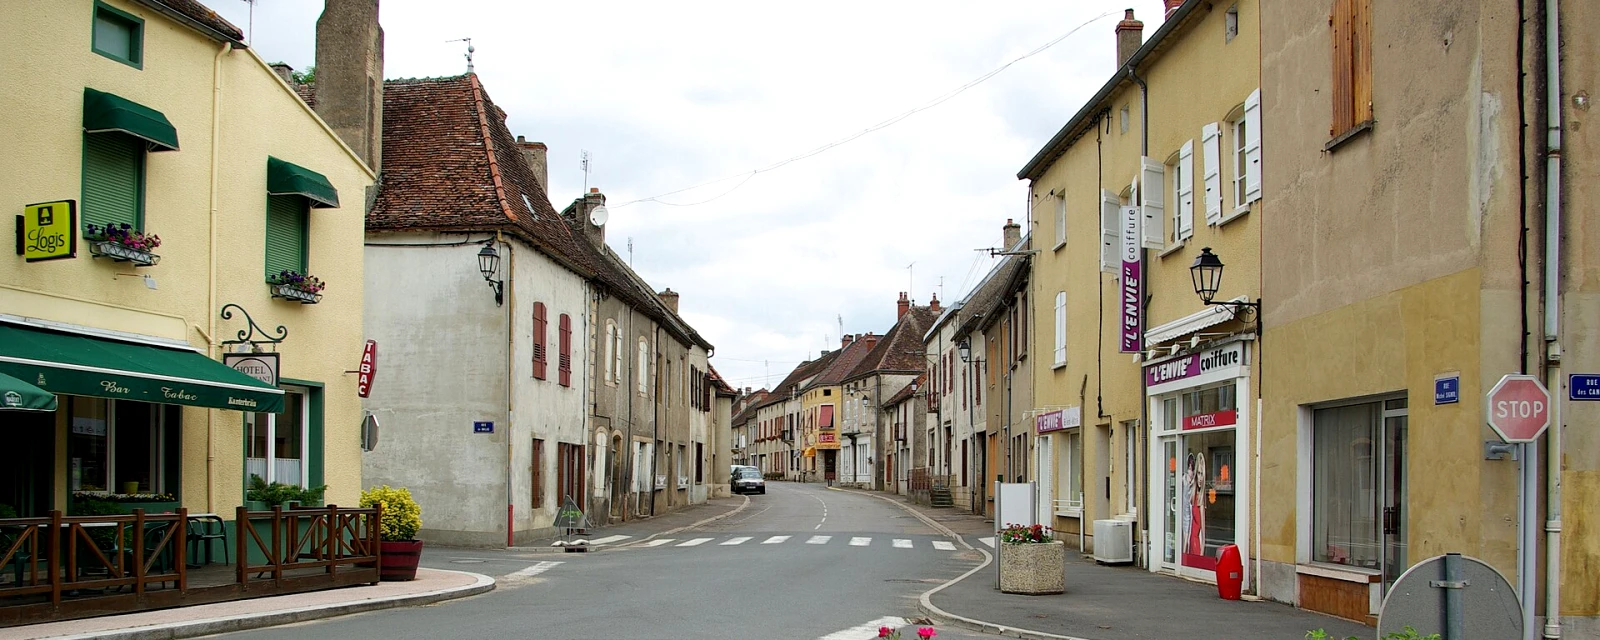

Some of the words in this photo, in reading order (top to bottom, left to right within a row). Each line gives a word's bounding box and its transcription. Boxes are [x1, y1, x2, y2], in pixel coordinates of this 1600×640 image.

[26, 227, 65, 253] Logis
[1126, 209, 1136, 260] coiffure
[236, 366, 266, 374] HOTEL
[359, 342, 373, 394] TABAC
[1201, 350, 1238, 371] coiffure
[100, 380, 130, 394] Bar
[161, 386, 198, 400] Tabac
[1496, 400, 1544, 418] STOP
[1192, 414, 1216, 426] MATRIX
